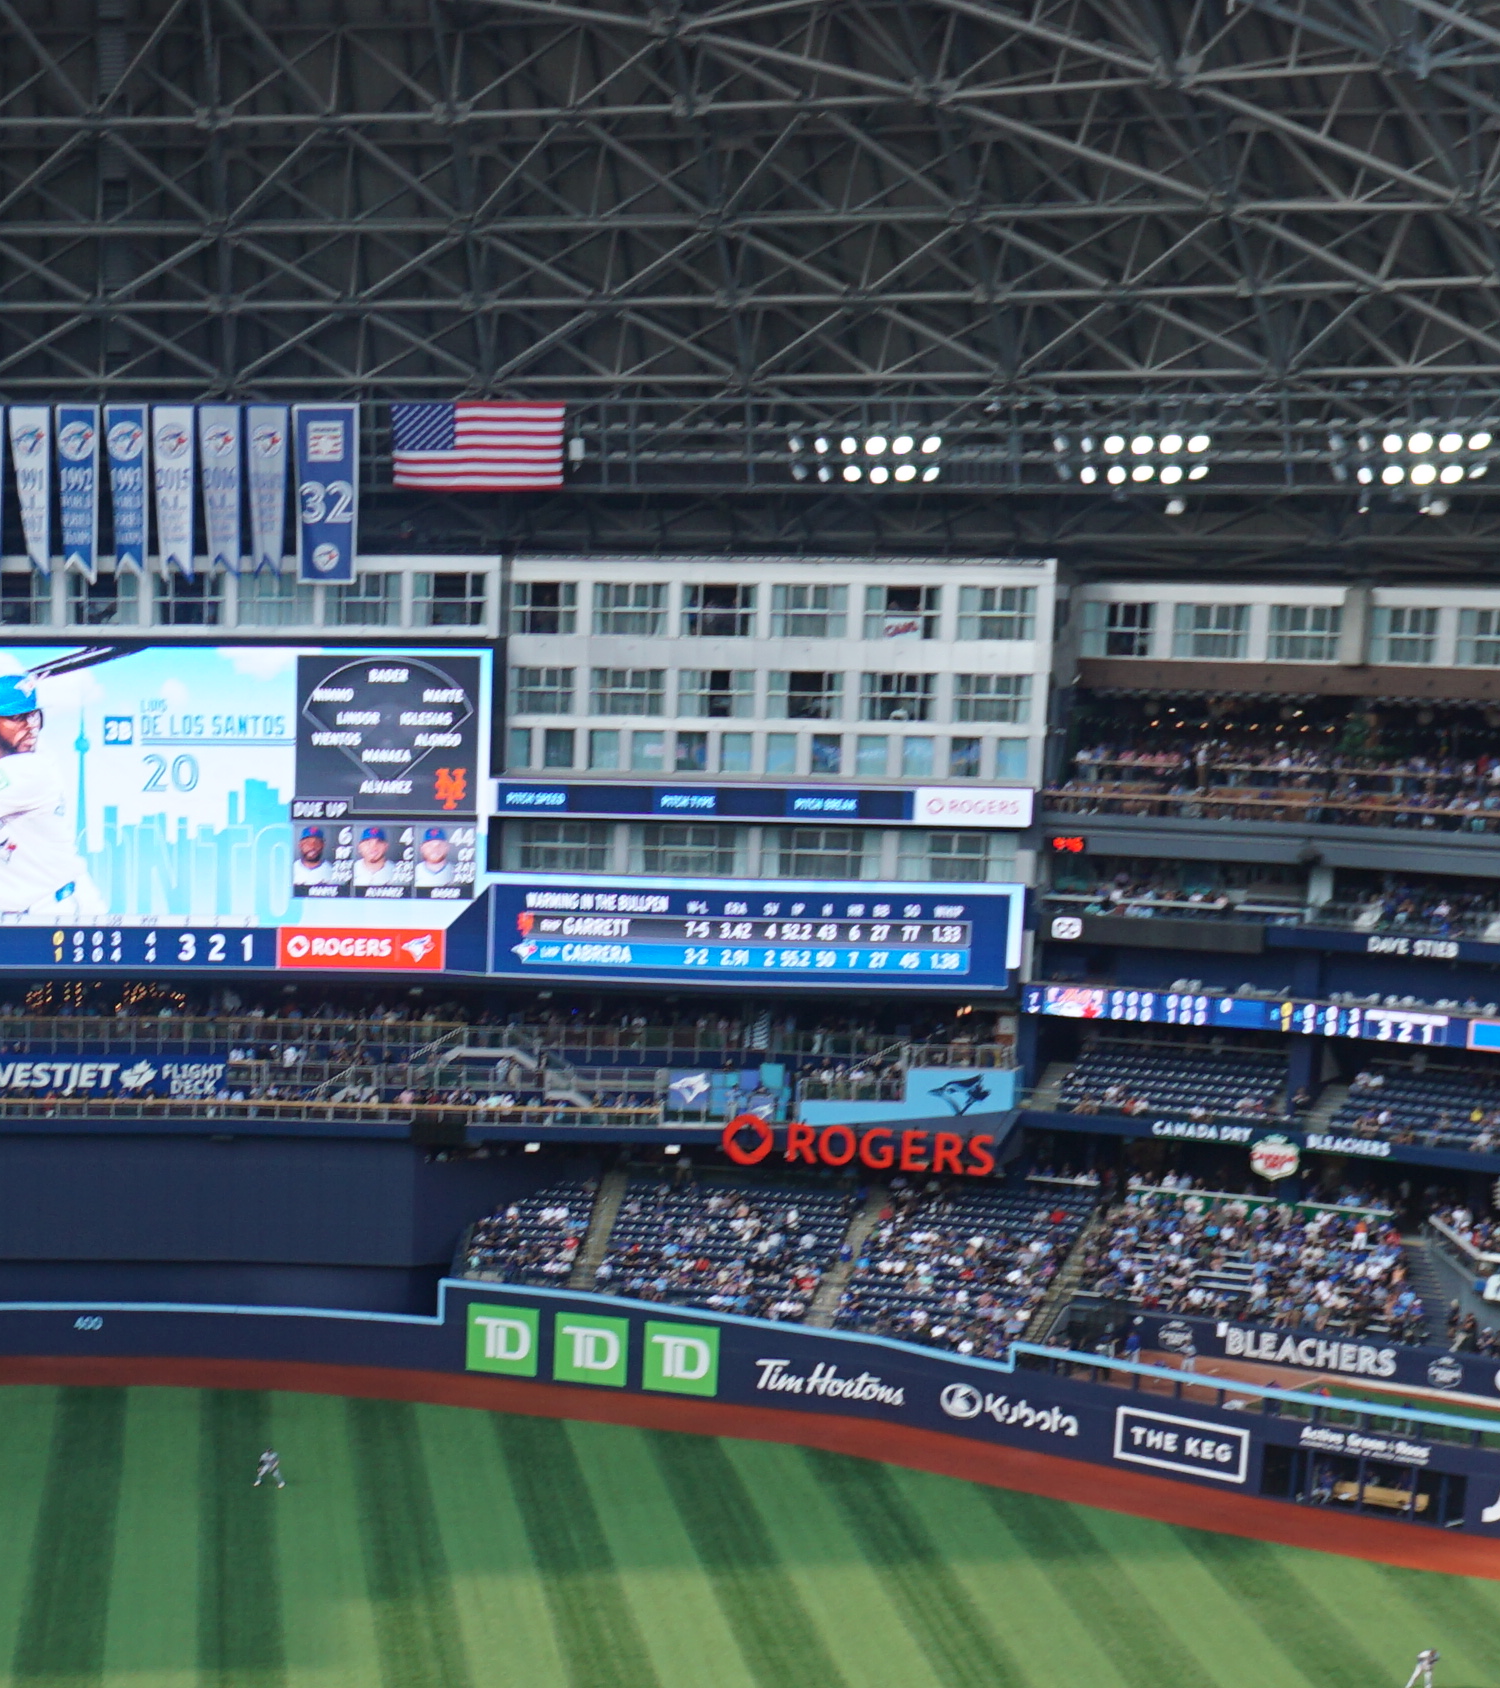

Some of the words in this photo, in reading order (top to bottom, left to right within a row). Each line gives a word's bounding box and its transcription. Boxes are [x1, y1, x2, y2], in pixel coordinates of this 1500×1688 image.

[60, 467, 93, 491] 1992
[110, 467, 142, 491] 1993
[300, 480, 353, 524] 32
[368, 669, 408, 684] BADER
[313, 688, 354, 702] NIMMO
[423, 688, 463, 703] MARTE
[141, 716, 163, 737] DE
[169, 716, 205, 737] LOS
[211, 715, 286, 737] SANTOS
[336, 712, 380, 726] LINDOR
[399, 712, 452, 726] IGLESIAS
[106, 720, 132, 742] 3B
[311, 732, 362, 747] VIENTOS
[414, 733, 462, 747] ALONSO
[362, 749, 412, 764] MANAEA
[142, 754, 199, 792] 20
[360, 780, 412, 795] ALVAREZ
[294, 803, 321, 818] DUE
[323, 803, 348, 819] UP
[449, 827, 474, 844] 44
[526, 892, 579, 910] WARMING
[580, 893, 594, 910] IN
[595, 893, 617, 911] THE
[618, 894, 669, 912] BULLPEN
[563, 917, 631, 937] GARRETT
[178, 934, 196, 961] 3
[209, 934, 226, 961] 2
[241, 934, 253, 961] 1
[311, 938, 391, 957] ROGERS
[562, 944, 632, 964] CABRERA
[1367, 936, 1409, 956] DAVE
[1413, 939, 1459, 959] STIEB
[162, 1063, 226, 1080] FLIGHT
[170, 1079, 216, 1095] DECK
[1151, 1120, 1219, 1140] CANADA
[1219, 1127, 1253, 1142] DRY
[786, 1125, 995, 1177] ROGERS
[1306, 1134, 1391, 1157] BLEACHERS
[73, 1316, 104, 1331] 400
[474, 1316, 531, 1361] TD
[562, 1325, 620, 1370] TD
[651, 1334, 711, 1380] TD
[1225, 1332, 1397, 1377] BLEACHERS
[755, 1357, 804, 1394] Tim
[805, 1362, 906, 1407] Hortons
[982, 1391, 1080, 1437] Kubota
[1131, 1425, 1178, 1455] THE
[1184, 1433, 1232, 1463] KEG
[1300, 1425, 1345, 1445] Active
[1347, 1433, 1387, 1452] Green
[1395, 1441, 1432, 1458] Ross
